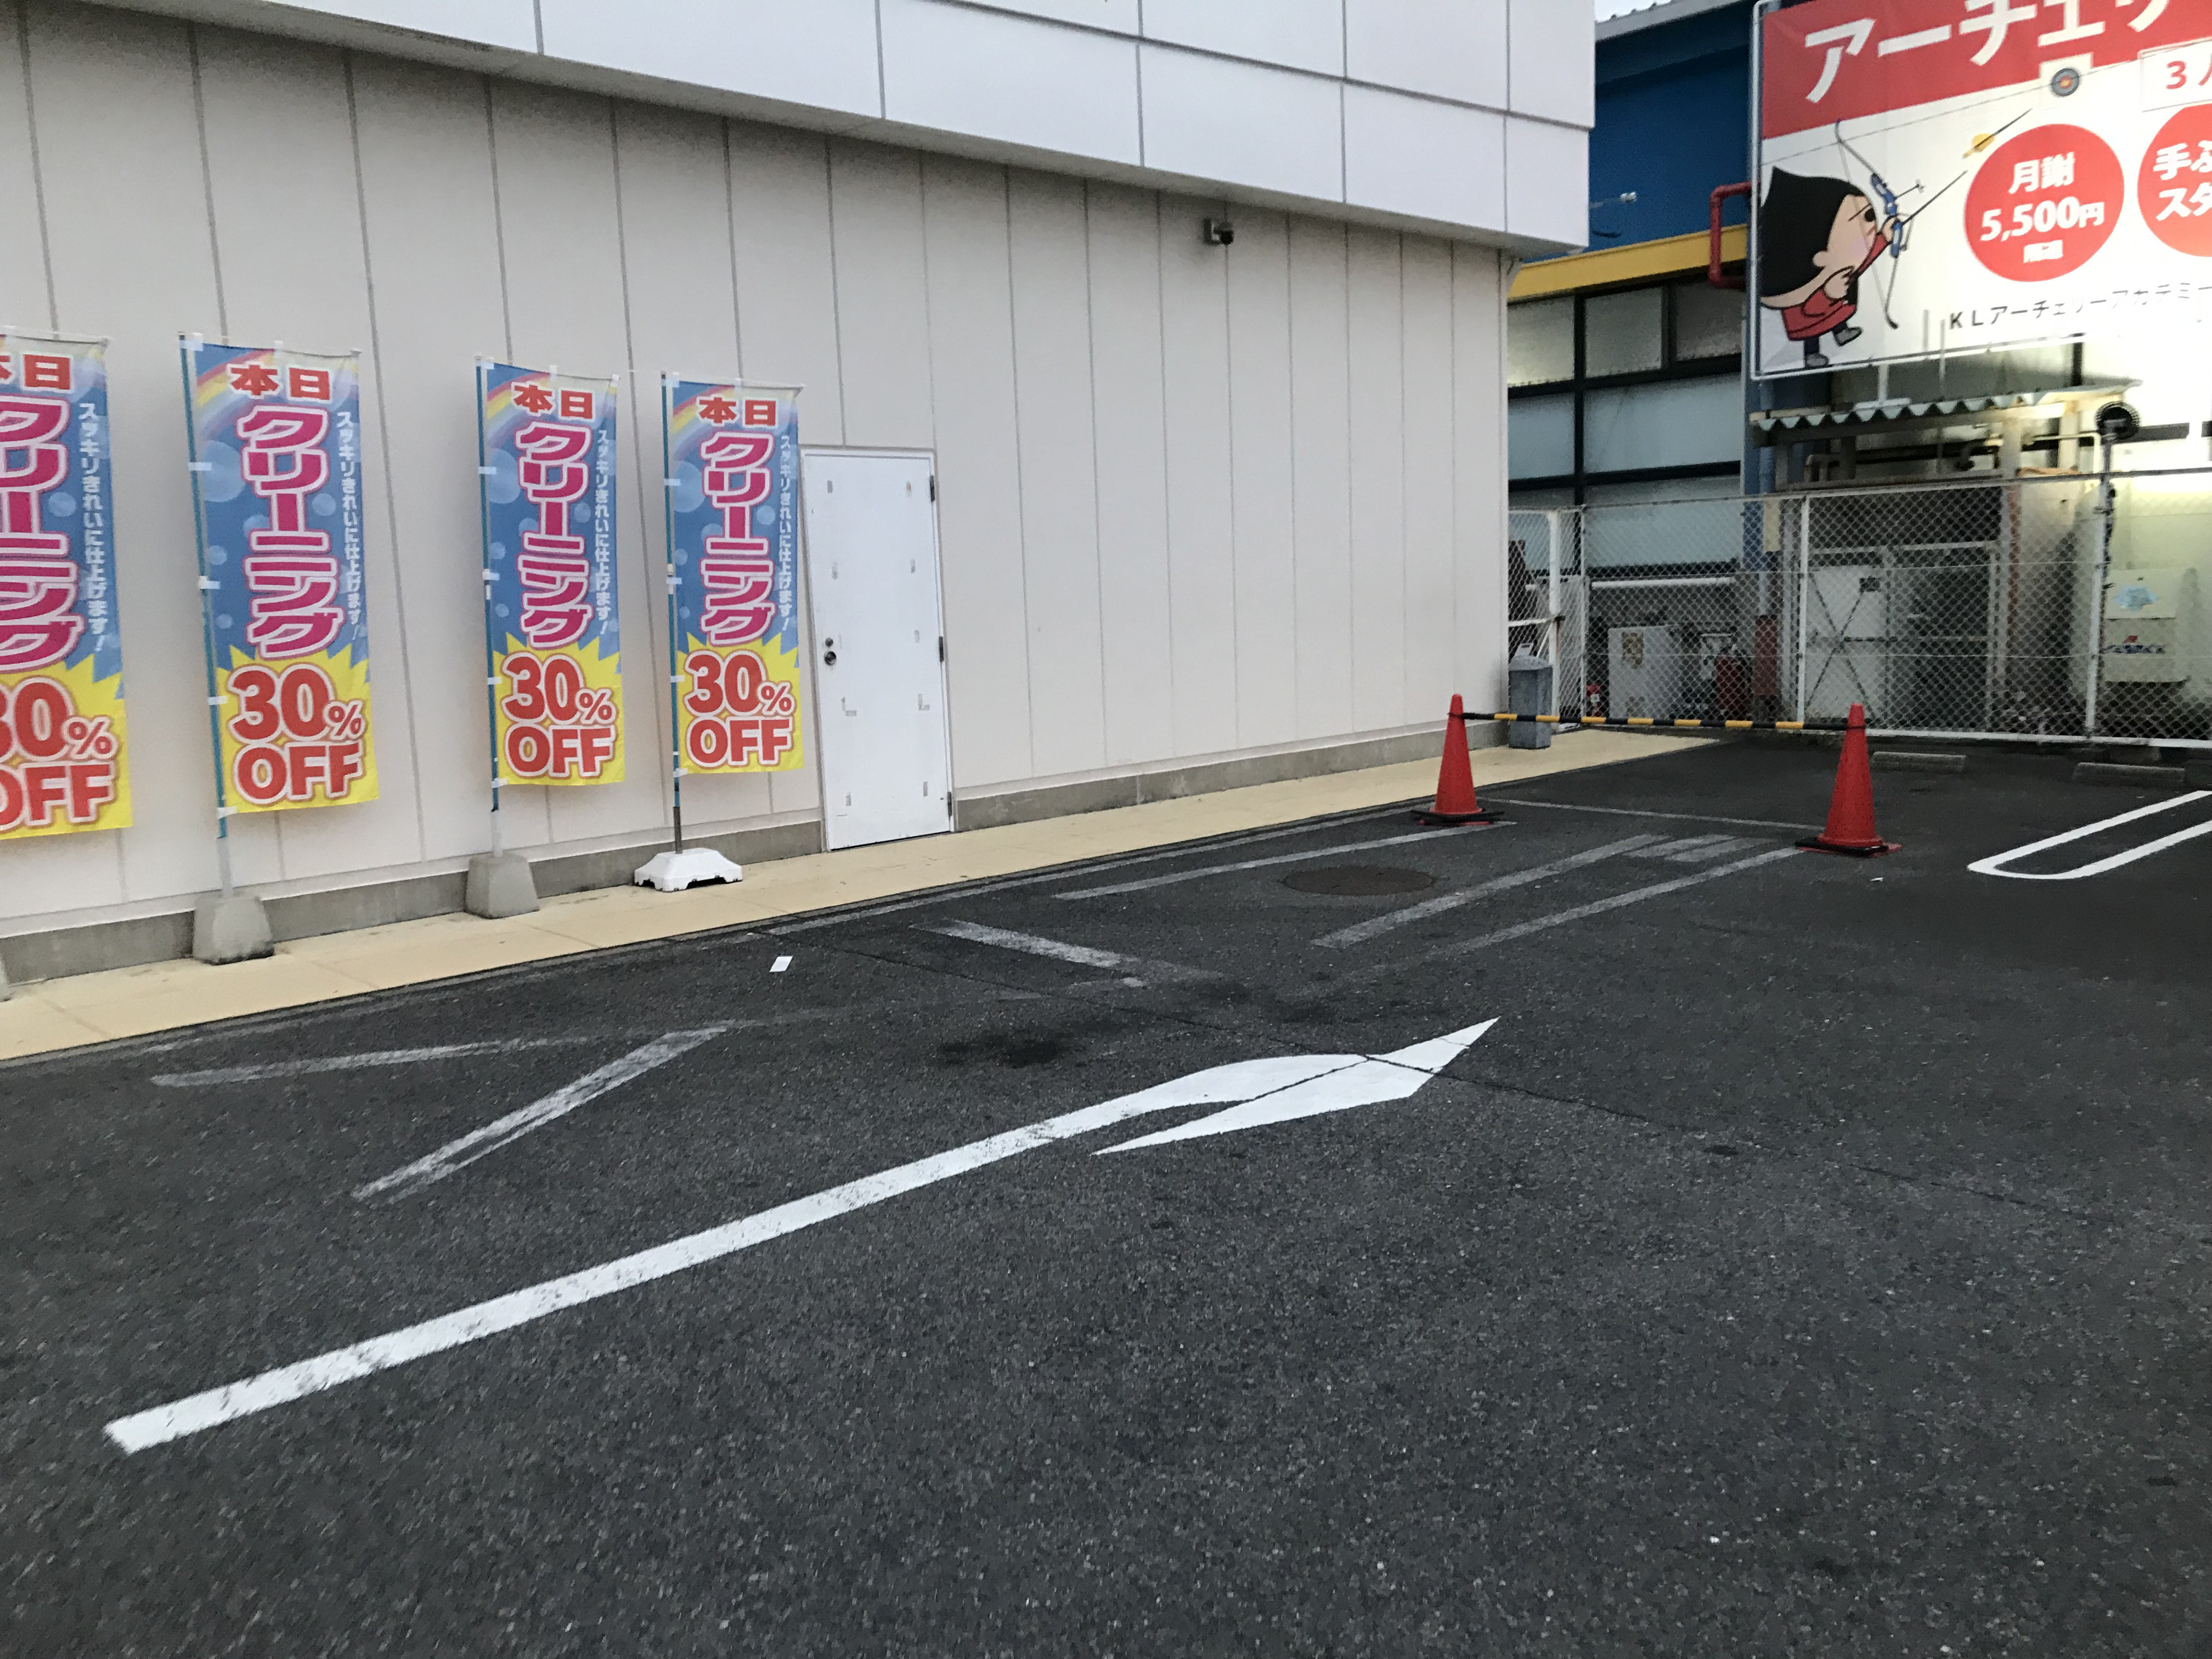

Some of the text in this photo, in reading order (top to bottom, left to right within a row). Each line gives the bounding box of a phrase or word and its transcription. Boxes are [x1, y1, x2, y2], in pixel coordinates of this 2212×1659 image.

[2007, 151, 2075, 195] 月謝
[1979, 196, 2105, 242] 5,500円
[231, 364, 331, 400] 本日
[514, 385, 594, 420] 本日
[699, 397, 776, 426] 本日
[239, 408, 342, 656] クリーニング
[518, 424, 592, 646] クリーニング
[702, 433, 775, 643] クリーニング
[231, 667, 363, 741] 30%
[504, 654, 613, 722] 30%
[686, 653, 793, 715] 30%
[0, 680, 113, 759] 0%
[688, 718, 791, 765] OFF
[237, 743, 360, 802] OFF
[507, 725, 612, 775] OFF
